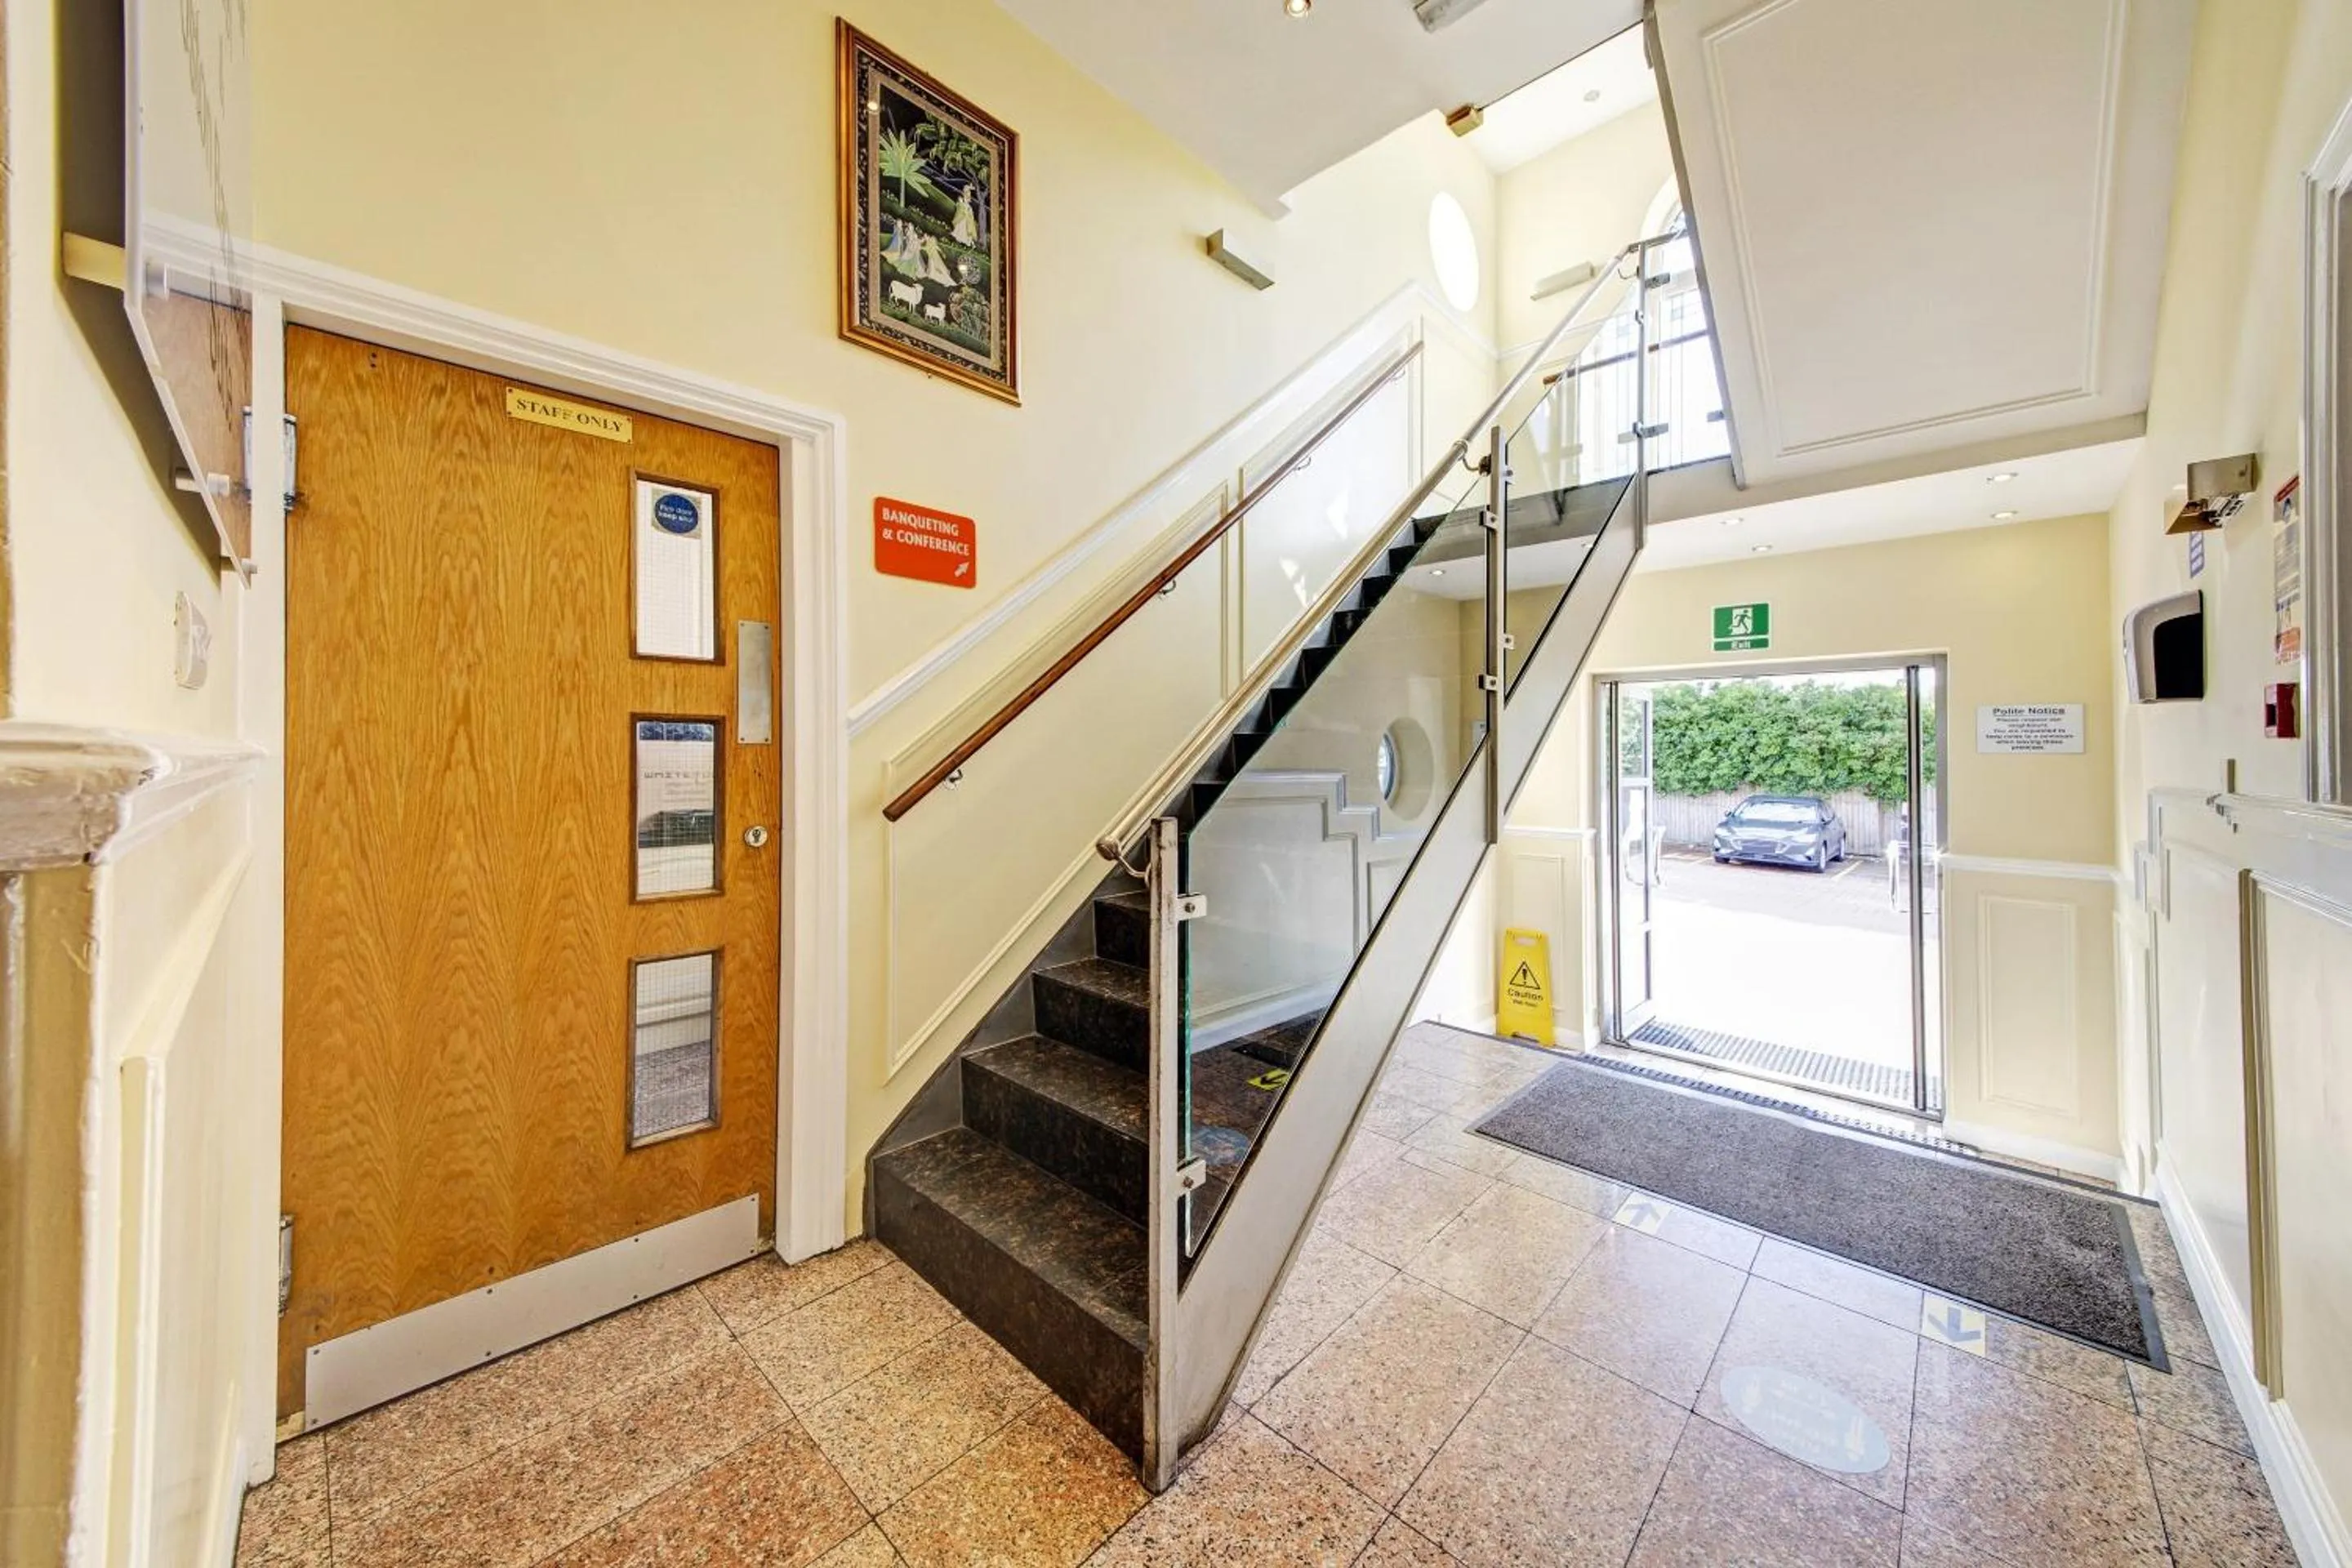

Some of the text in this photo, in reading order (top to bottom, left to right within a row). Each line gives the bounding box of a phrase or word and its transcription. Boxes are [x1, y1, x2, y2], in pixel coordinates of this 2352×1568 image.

[516, 398, 623, 432] STAFF ONLY
[882, 507, 960, 537] BANQUETING
[882, 528, 970, 557] & CONFERENCE
[1993, 707, 2065, 715] Polite Notice
